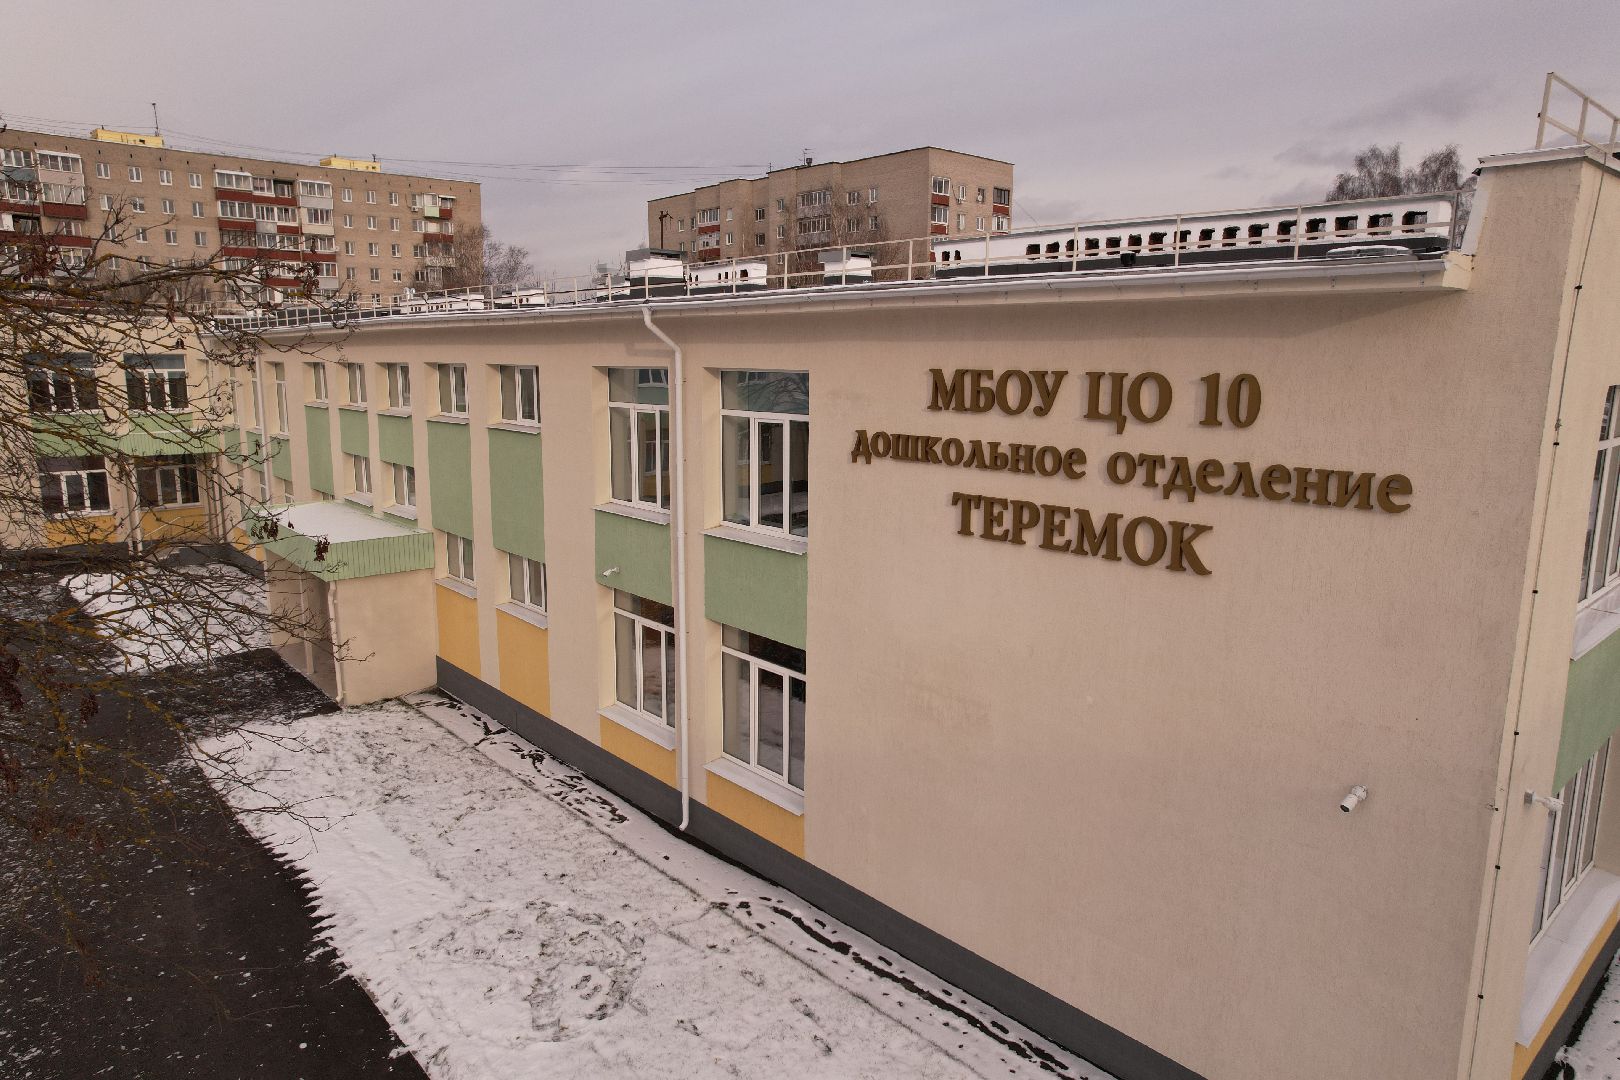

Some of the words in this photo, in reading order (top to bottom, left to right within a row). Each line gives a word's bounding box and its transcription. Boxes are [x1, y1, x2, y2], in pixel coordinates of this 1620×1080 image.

[927, 369, 1068, 416] МБОУ
[1084, 372, 1172, 435] ЦО
[1199, 373, 1261, 429] 10
[851, 430, 1087, 480] дошкольное
[1106, 452, 1412, 514] отделение
[952, 492, 1213, 576] ТЕРЕМОК
